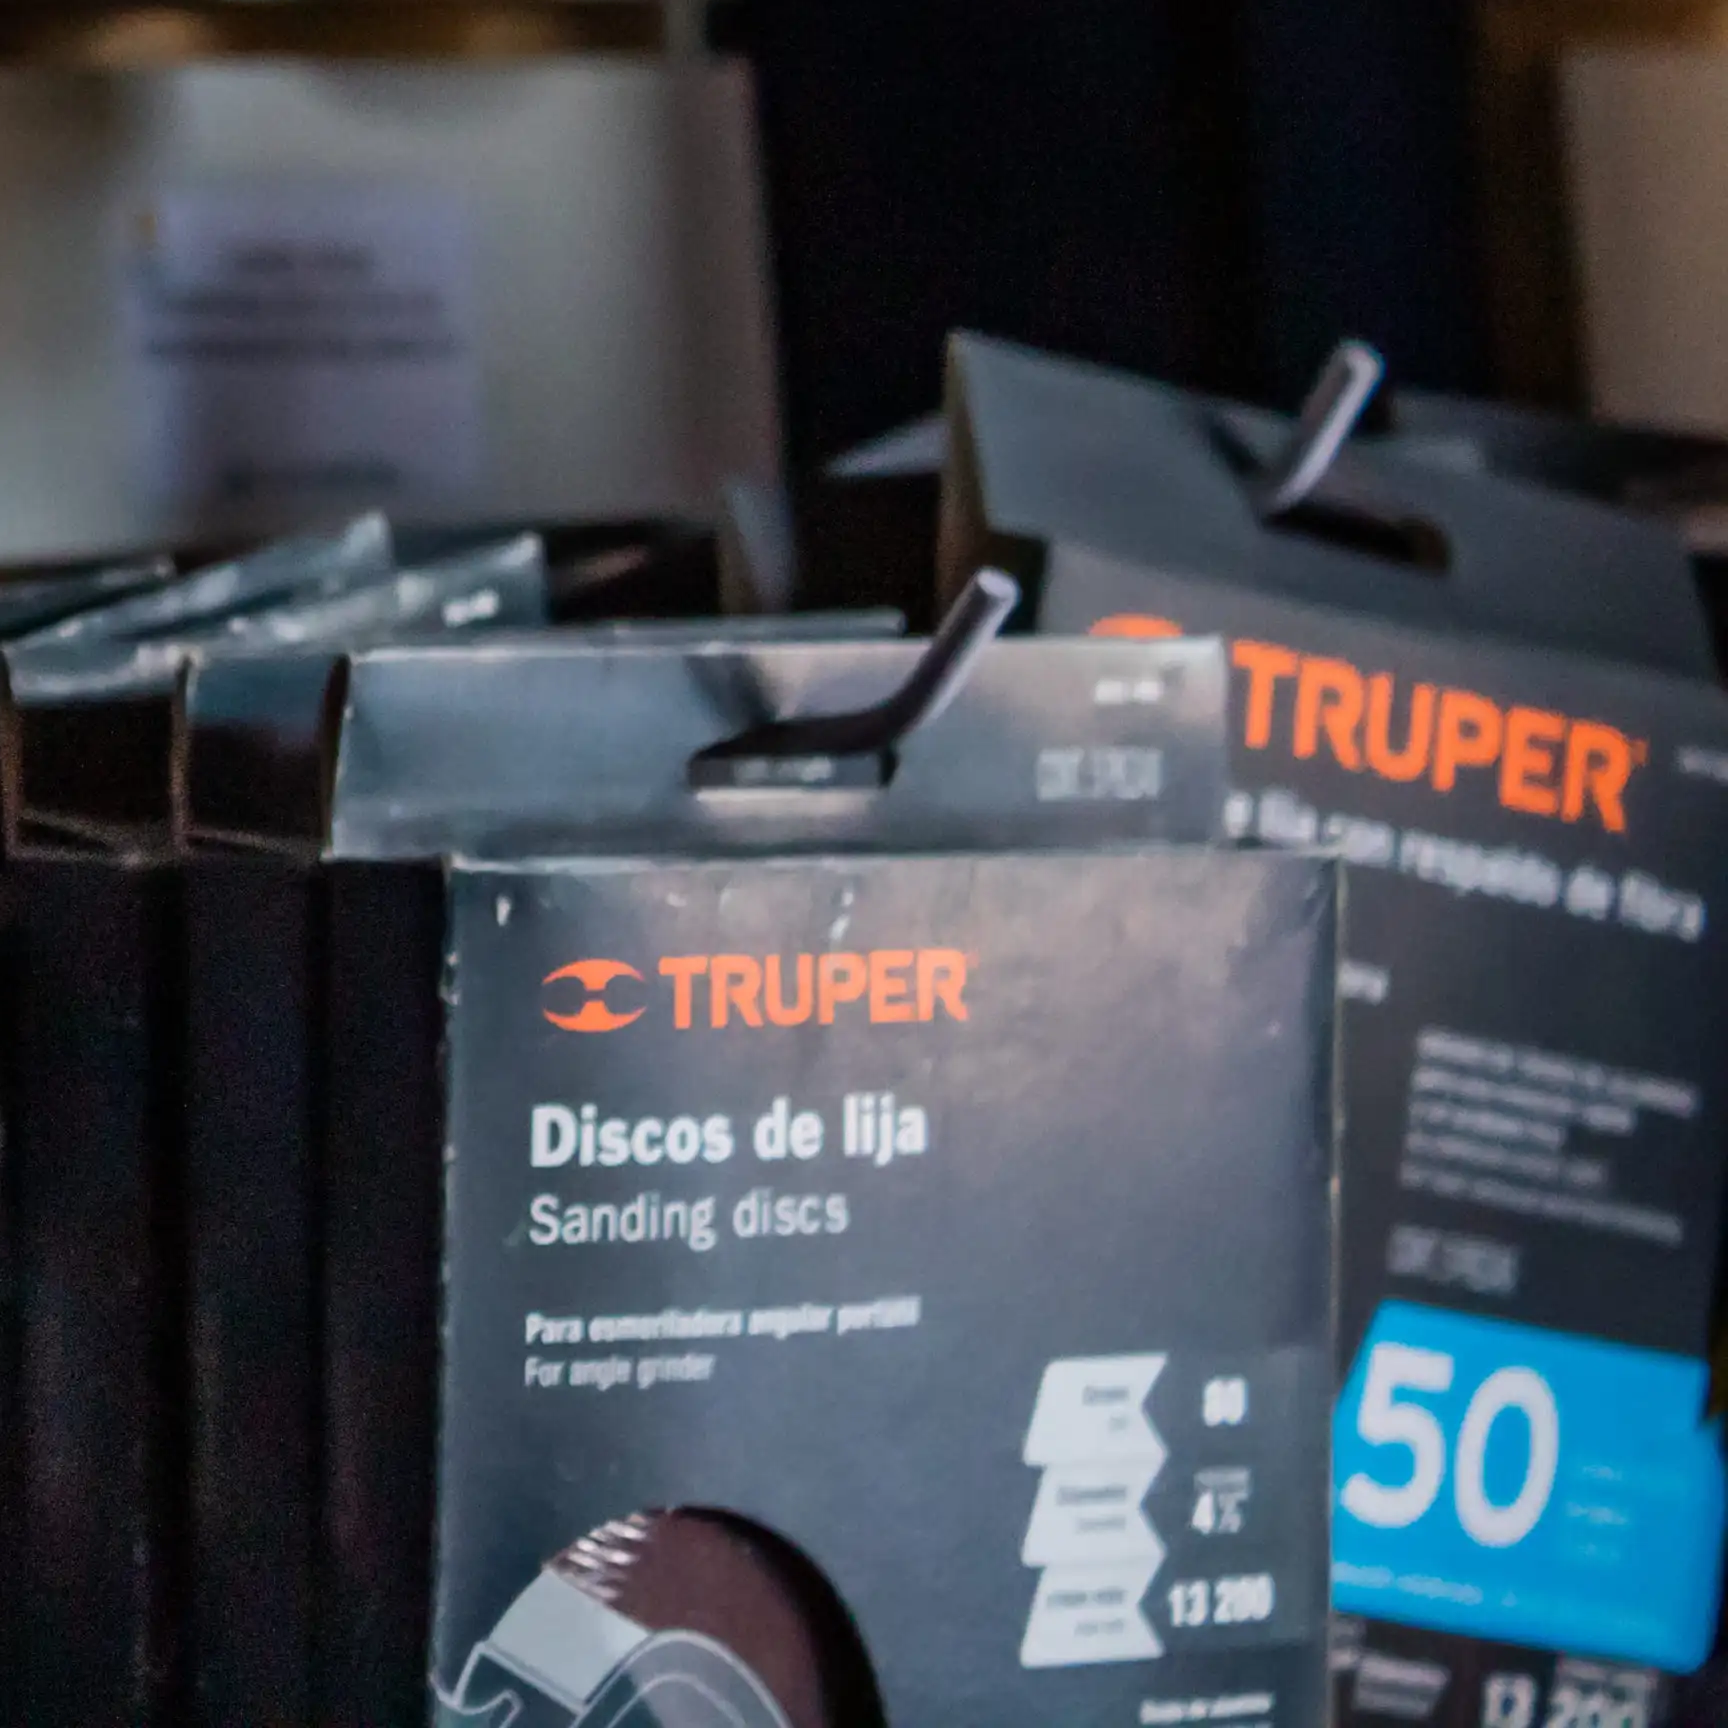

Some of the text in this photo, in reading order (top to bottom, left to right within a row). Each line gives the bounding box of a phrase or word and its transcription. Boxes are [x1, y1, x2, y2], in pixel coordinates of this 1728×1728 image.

[1233, 638, 1629, 833] TRUPER
[659, 948, 969, 1029] TRUPER
[530, 1092, 929, 1167] Discos de lija
[528, 1186, 850, 1251] Sanding discs
[1340, 1341, 1560, 1549] 50
